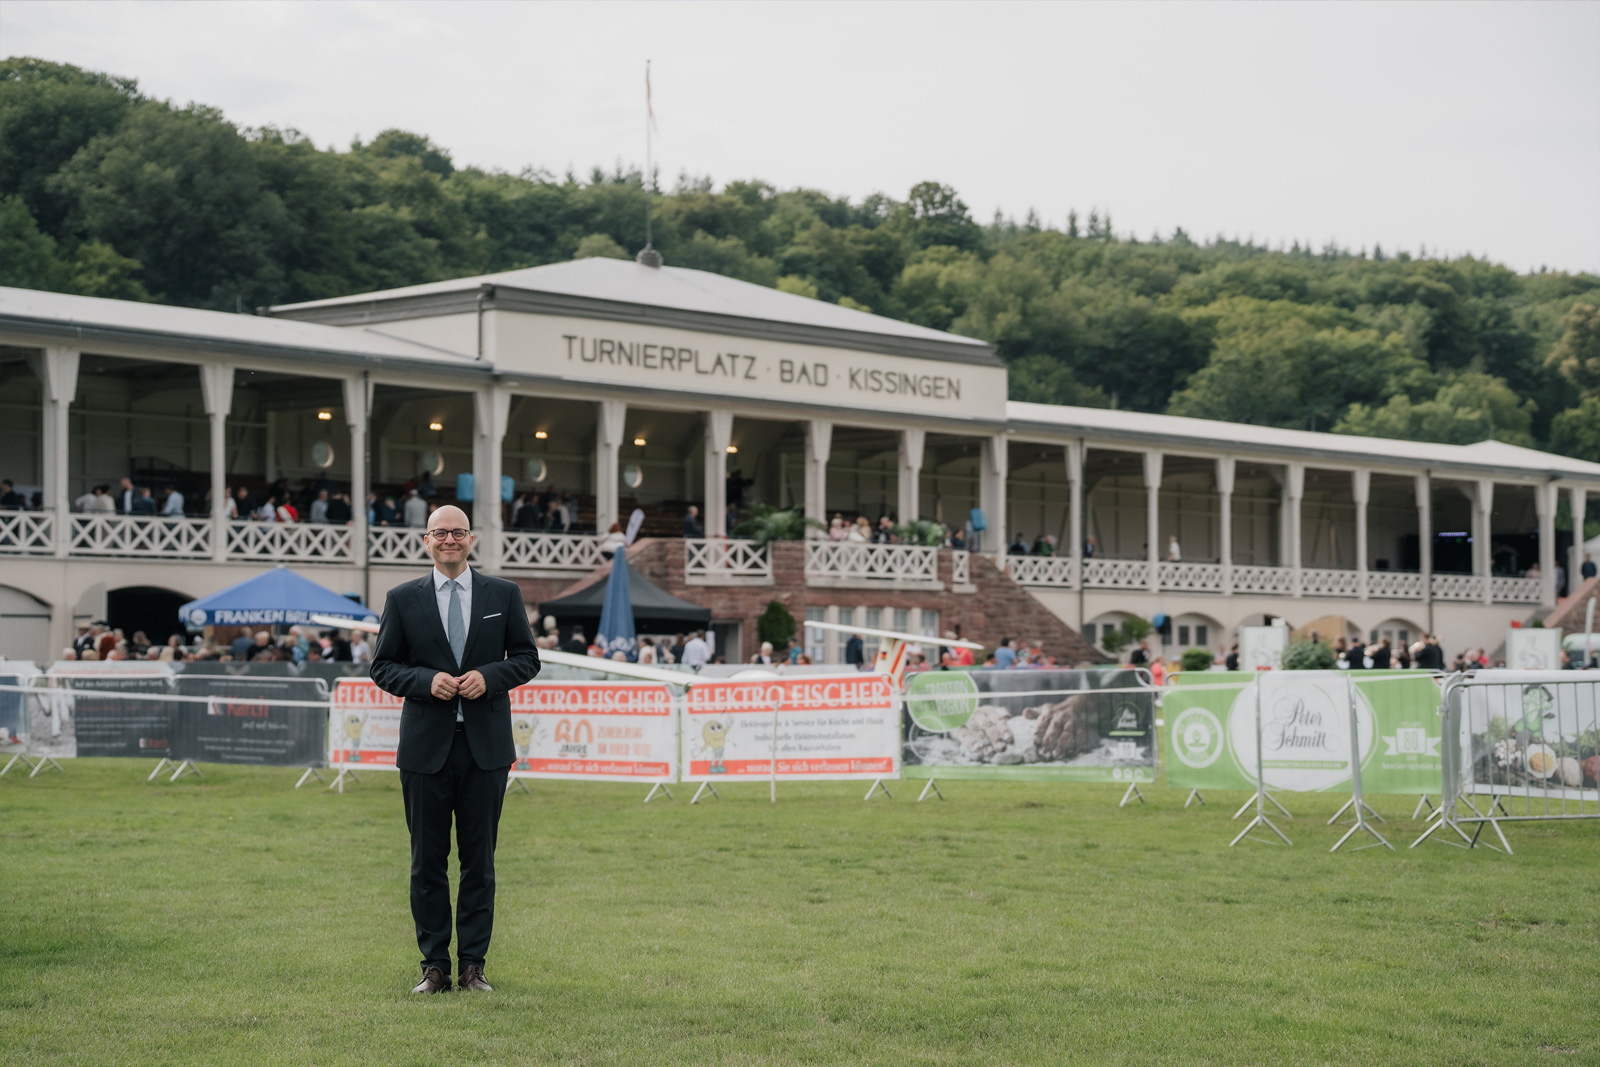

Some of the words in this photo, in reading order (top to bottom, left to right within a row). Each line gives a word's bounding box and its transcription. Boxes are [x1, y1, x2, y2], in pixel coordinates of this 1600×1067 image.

[562, 335, 757, 380] TURNIERPLATZ
[780, 359, 828, 387] BAD
[849, 367, 961, 401] KISSINGEN
[214, 610, 284, 624] FRANKEN
[588, 690, 666, 713] FISCHER
[692, 685, 785, 711] ELEKTRO
[792, 681, 885, 708] FISCHER
[1278, 697, 1322, 727] Peter
[754, 733, 792, 741] Indiviuelle
[1267, 724, 1333, 752] Schmitt
[1403, 731, 1418, 750] 80
[573, 762, 583, 772] Sie
[585, 762, 599, 772] sich
[600, 763, 633, 773] verlassen
[746, 764, 772, 773] worau
[778, 761, 790, 772] Sie
[792, 761, 809, 772] sich
[810, 760, 849, 772] verlassen
